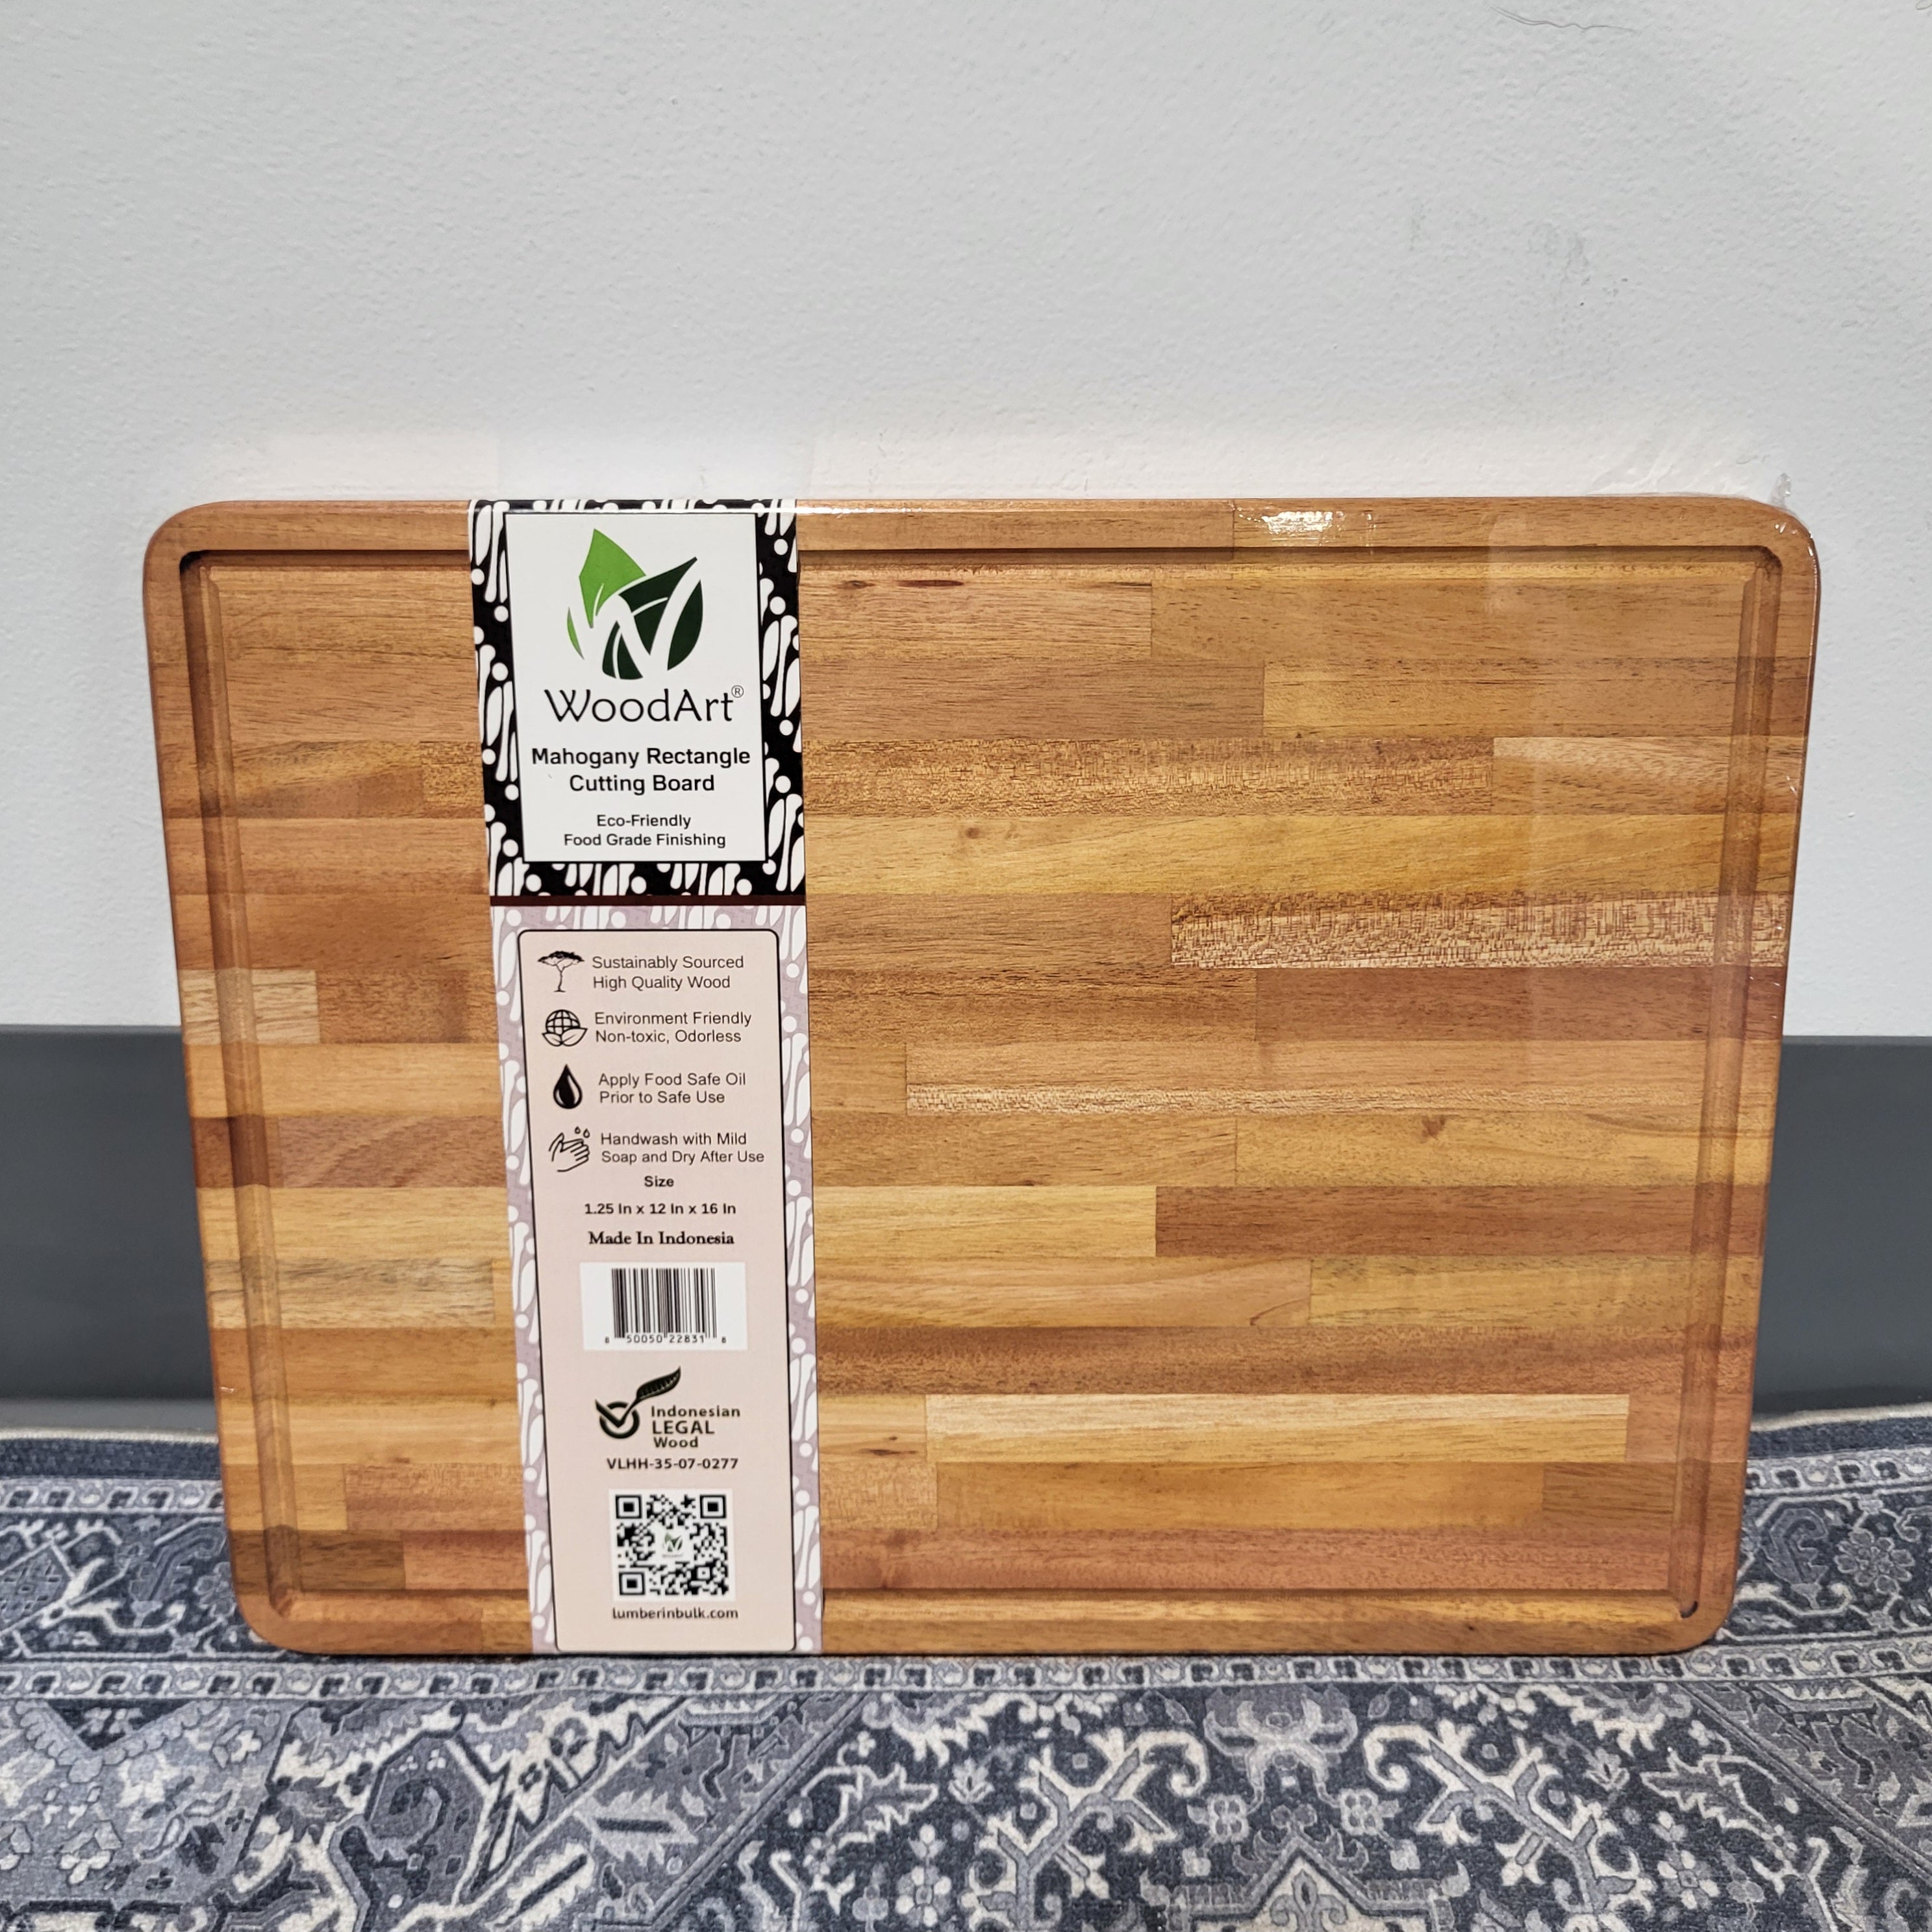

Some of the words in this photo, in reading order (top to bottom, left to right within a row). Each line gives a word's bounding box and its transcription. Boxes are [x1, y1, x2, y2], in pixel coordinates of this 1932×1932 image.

[531, 747, 640, 770] Mahogany
[646, 747, 751, 769] Rectangle
[569, 774, 646, 796] Cutting
[652, 774, 715, 792] Board
[596, 814, 692, 830] Eco-Friendly
[564, 833, 602, 846] Food
[606, 833, 652, 846] Grade
[656, 833, 726, 849] Finishing
[592, 955, 678, 972] Sustainably
[682, 955, 744, 969] Sourced
[593, 975, 627, 992] High
[631, 975, 683, 992] Quality
[686, 975, 731, 988] Wood
[594, 1011, 688, 1025] Environment
[693, 1011, 752, 1028] Friendly
[596, 1029, 670, 1044] Non-toxic,
[675, 1029, 742, 1043] Odorless
[598, 1073, 640, 1089] Apply
[644, 1072, 682, 1086] Food
[687, 1072, 721, 1086] Safe
[725, 1072, 746, 1086] Oil
[599, 1090, 634, 1104] Prior
[638, 1091, 653, 1104] to
[657, 1090, 691, 1104] Safe
[696, 1090, 725, 1103] Use
[601, 1132, 678, 1146] Handwash
[683, 1132, 712, 1146] with
[717, 1132, 747, 1146] Mild
[601, 1150, 637, 1166] Soap
[642, 1150, 668, 1163] and
[672, 1150, 696, 1166] Dry
[700, 1150, 734, 1163] After
[737, 1150, 765, 1162] Use
[644, 1175, 675, 1188] Size
[584, 1203, 614, 1215] 1.25
[636, 1205, 645, 1215] x
[649, 1203, 667, 1215] 12
[688, 1205, 697, 1214] x
[701, 1203, 718, 1214] 16
[588, 1231, 632, 1245] Made
[635, 1231, 654, 1245] In
[658, 1231, 735, 1245] Indonesia
[626, 1334, 663, 1344] 50050
[669, 1334, 704, 1344] 22831
[651, 1404, 741, 1418] Indonesian
[652, 1420, 715, 1435] LEGAL
[653, 1436, 699, 1449] Wood
[606, 1457, 738, 1470] VLHH-35-07-0277
[612, 1607, 739, 1620] lumberinbulk.com
